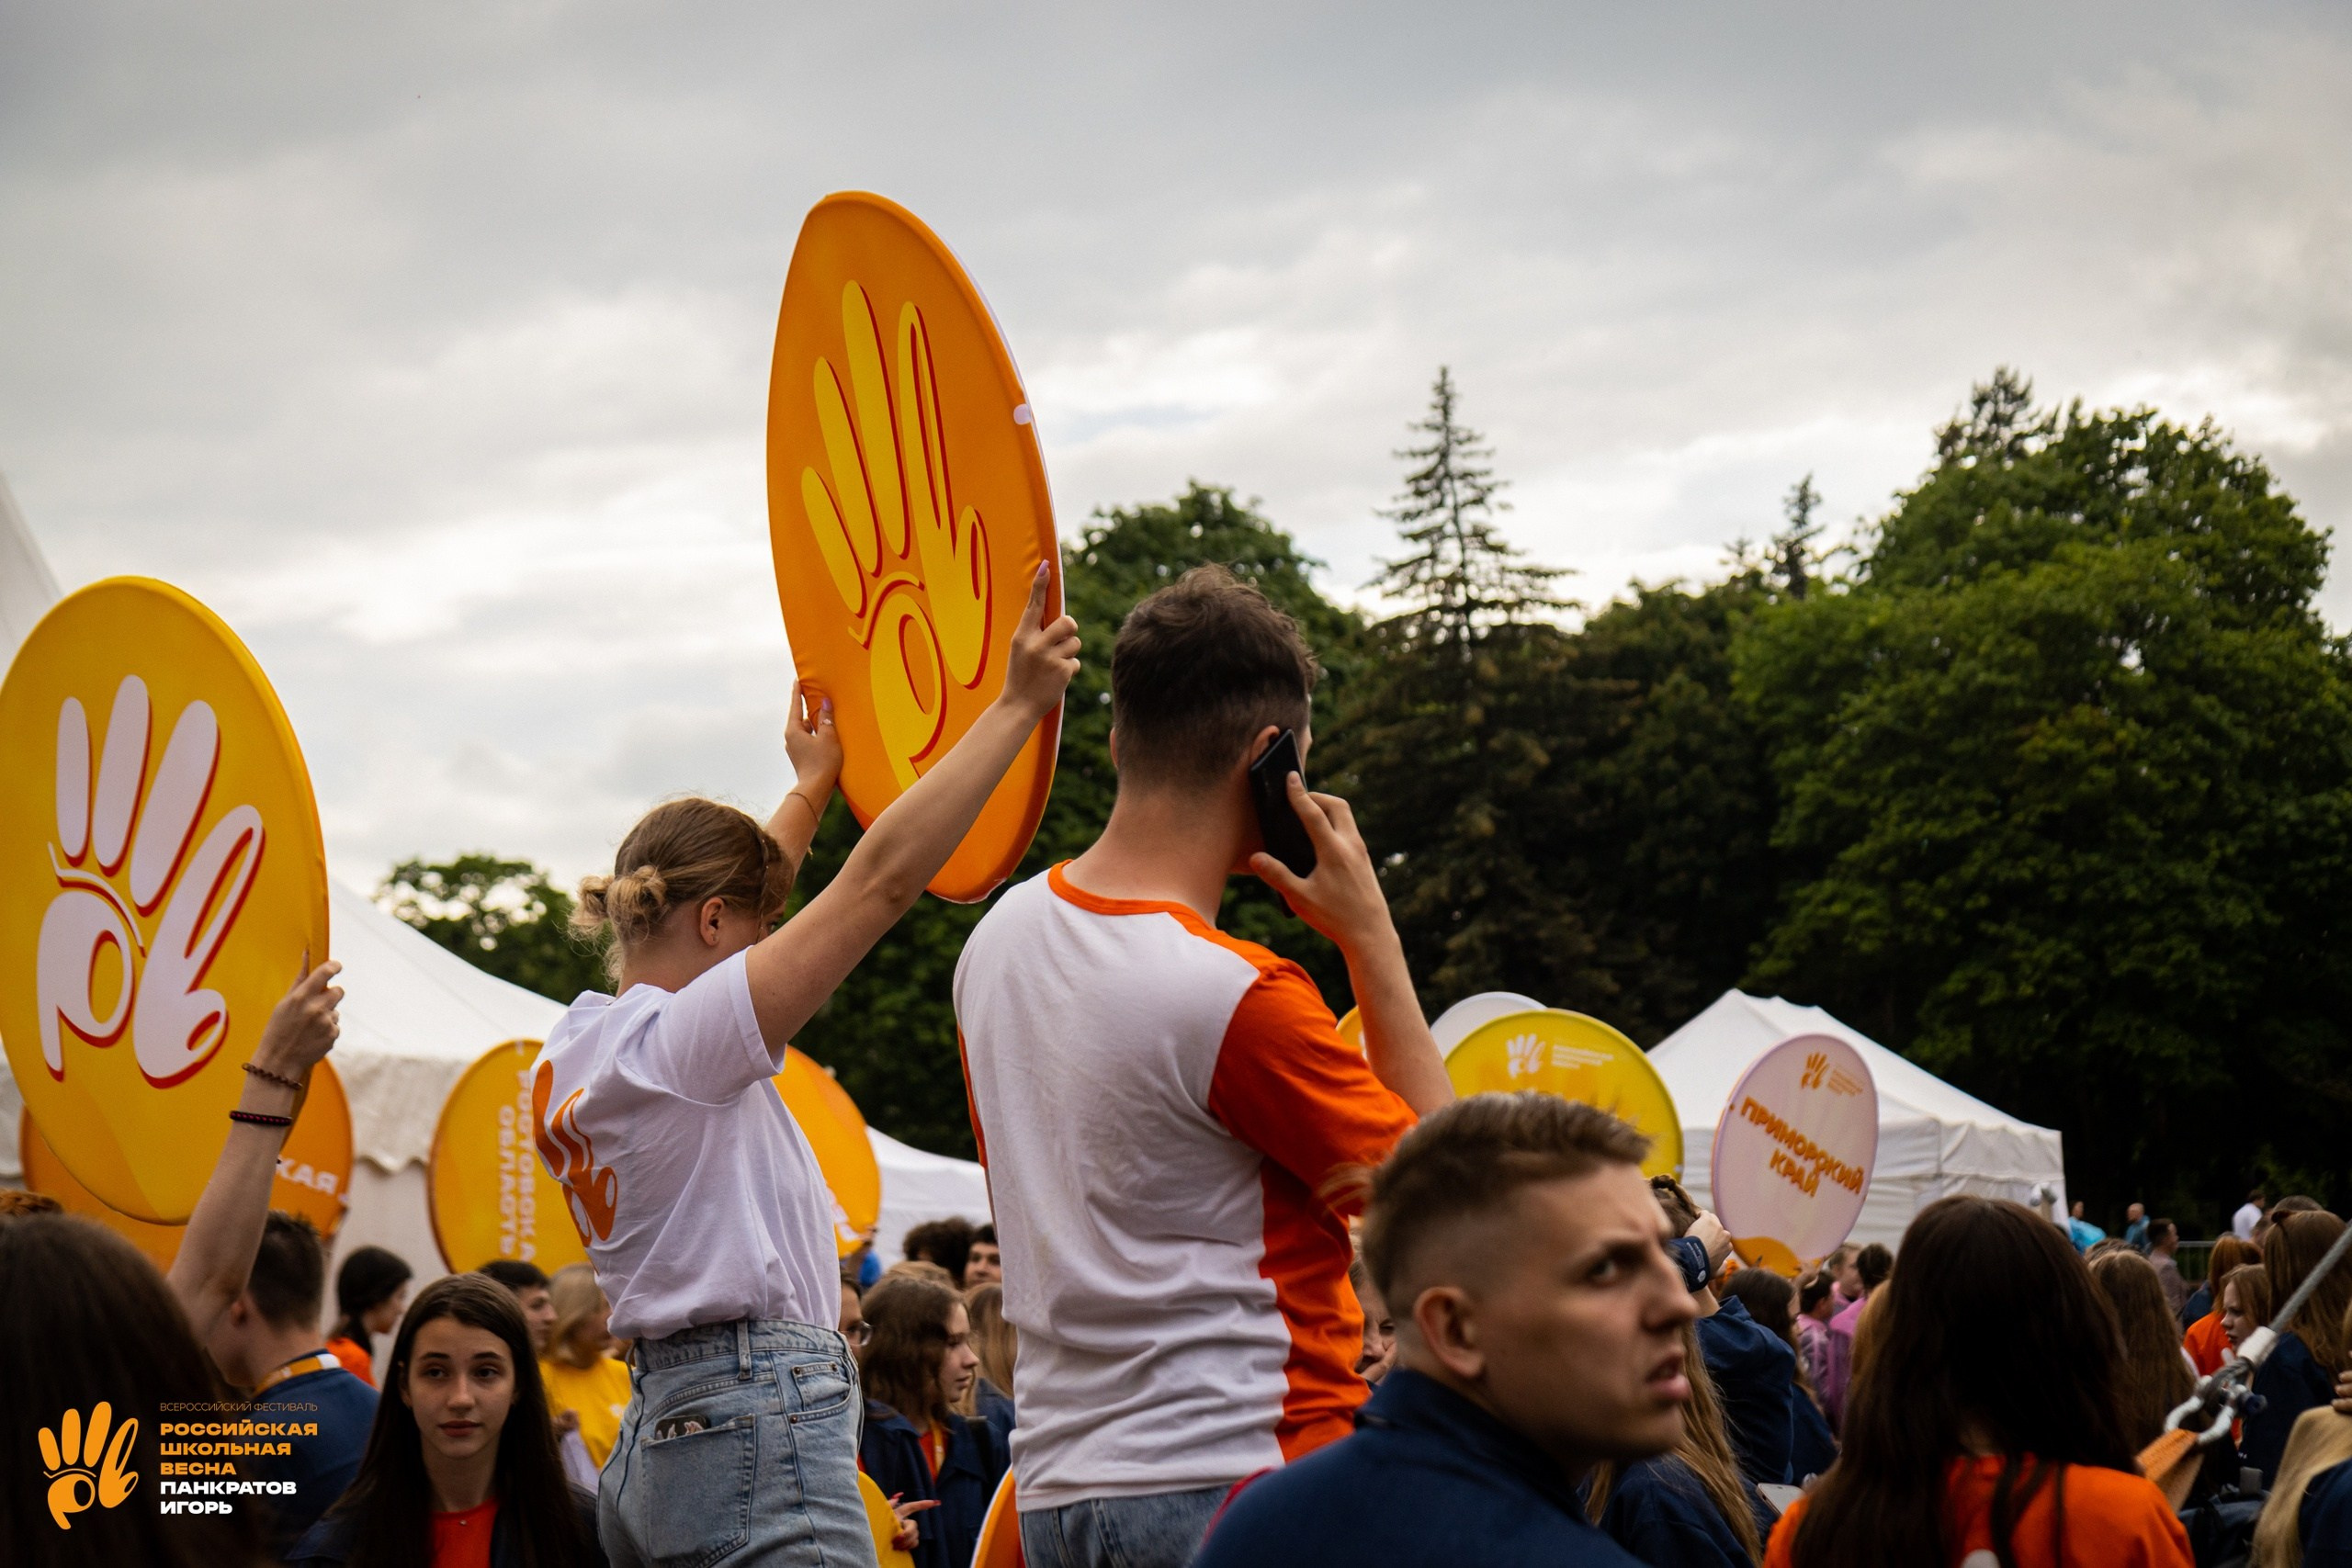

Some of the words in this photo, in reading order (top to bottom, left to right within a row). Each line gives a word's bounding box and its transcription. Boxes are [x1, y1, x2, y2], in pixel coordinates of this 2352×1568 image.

[499, 1105, 515, 1255] ОБЛАСТЬ
[517, 1070, 536, 1261] РОСТОВСКА
[1740, 1096, 1864, 1195] ПРИМОРСКИЙ
[1770, 1148, 1820, 1198] КРАЙ
